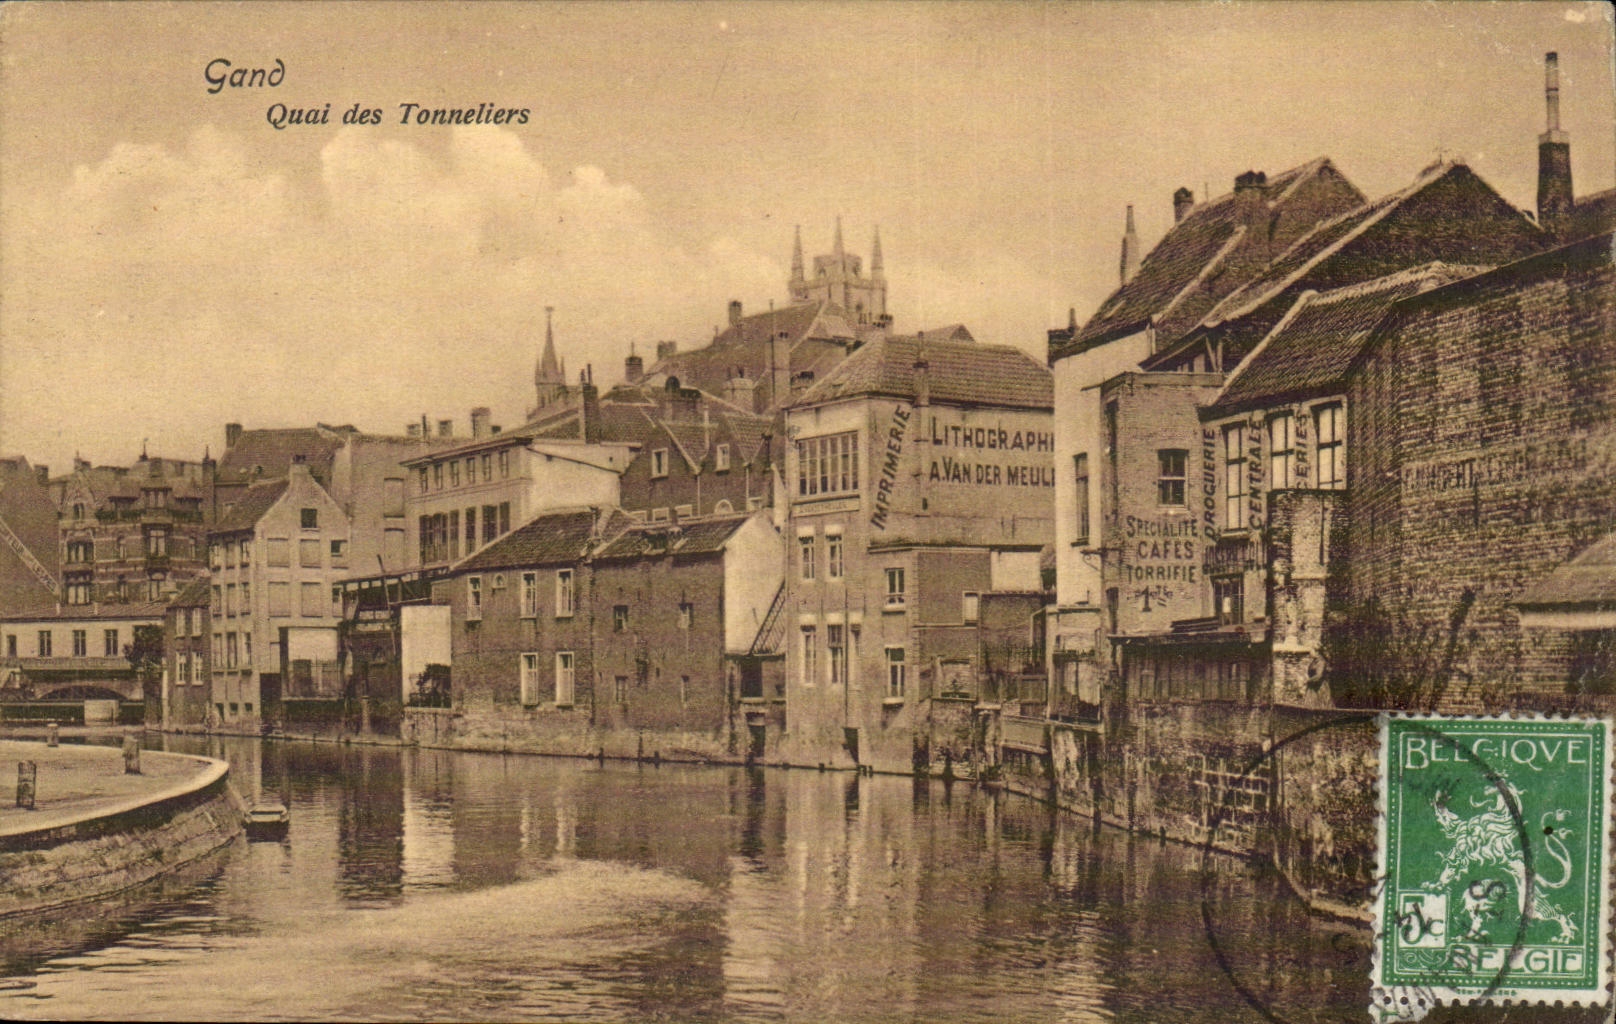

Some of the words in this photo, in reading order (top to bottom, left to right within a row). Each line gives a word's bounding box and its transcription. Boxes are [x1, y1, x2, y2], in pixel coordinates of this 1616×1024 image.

[870, 404, 911, 531] IMPRIMERIE
[976, 463, 1002, 486] DER
[1203, 428, 1218, 543] DROGUERIE
[1249, 419, 1263, 531] CENTRALE
